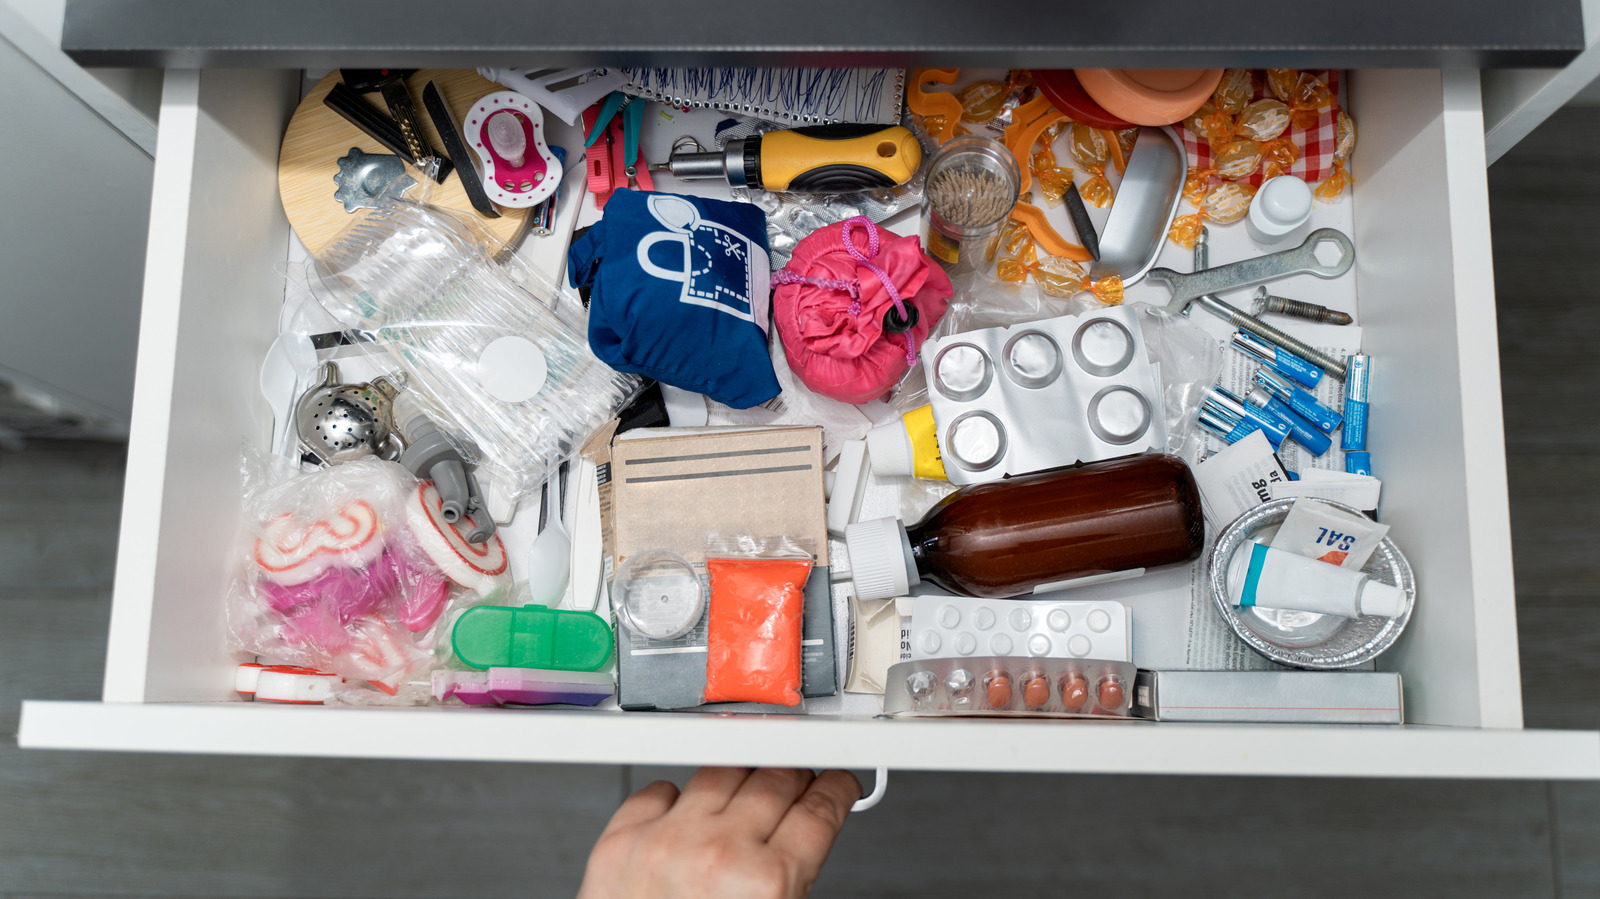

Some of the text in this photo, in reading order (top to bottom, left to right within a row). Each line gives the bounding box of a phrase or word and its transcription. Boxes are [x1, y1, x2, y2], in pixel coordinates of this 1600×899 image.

[1251, 478, 1271, 503] mg
[1315, 526, 1356, 551] SAL
[900, 629, 912, 640] id
